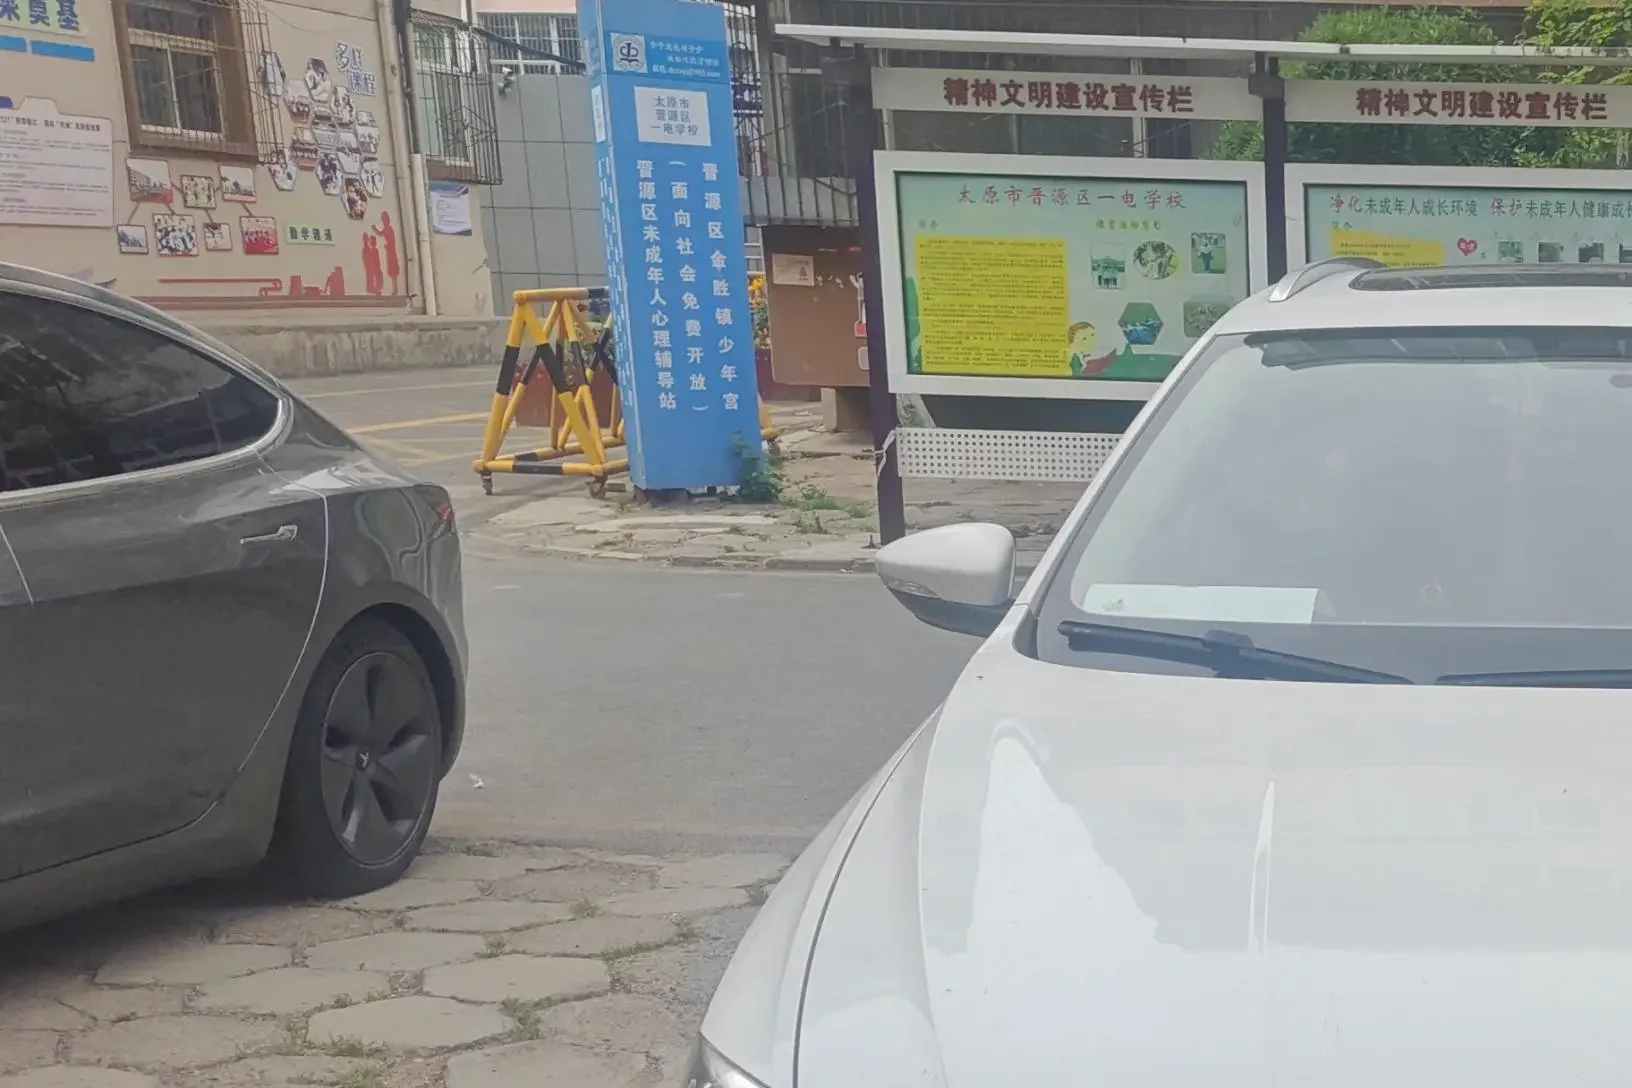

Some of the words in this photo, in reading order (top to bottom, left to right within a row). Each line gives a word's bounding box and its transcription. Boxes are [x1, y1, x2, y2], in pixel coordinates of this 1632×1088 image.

[943, 77, 1194, 113] 精神文明建设宣传栏
[1355, 87, 1608, 121] 精神文明建设宣传栏
[958, 184, 1187, 210] 太原市晋源区一电学校
[1330, 192, 1480, 217] 净化未成年人成长环境
[636, 159, 677, 411] 晋源区未成年人心理辅导站
[702, 161, 740, 411] 晋源区金胜镇少年宫
